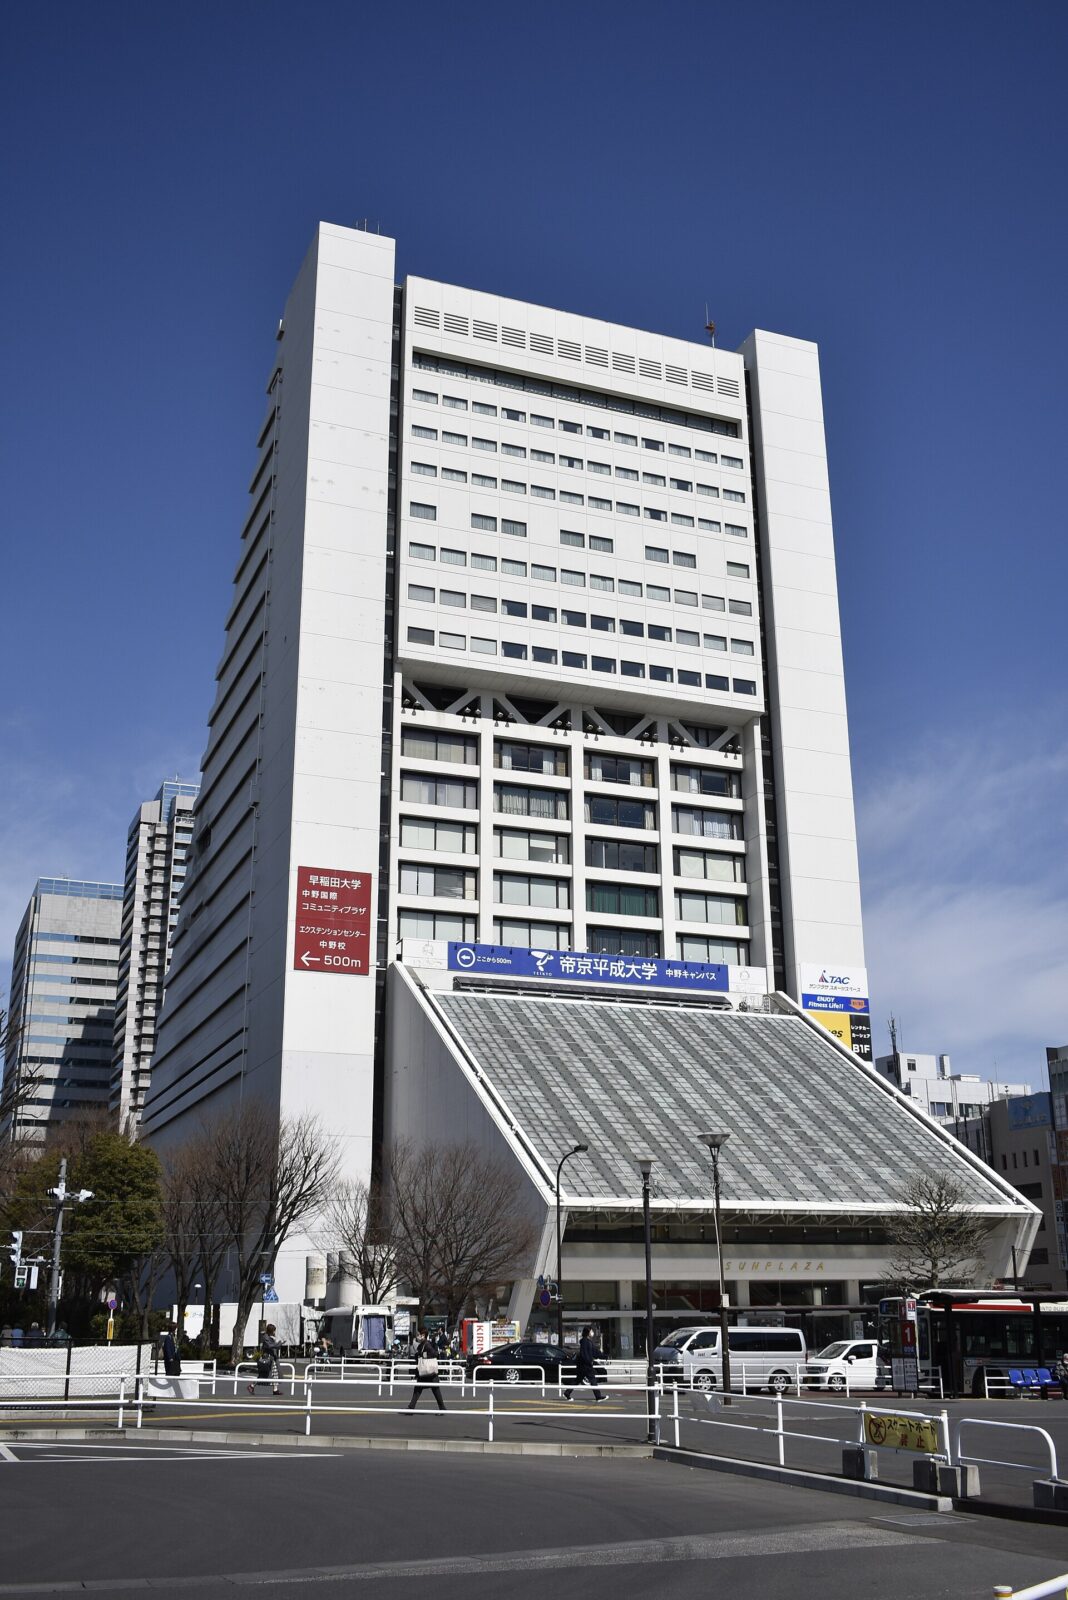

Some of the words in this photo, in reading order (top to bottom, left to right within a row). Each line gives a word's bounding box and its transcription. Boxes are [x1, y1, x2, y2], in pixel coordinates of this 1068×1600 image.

[309, 875, 362, 889] 早稲田大学
[302, 890, 338, 900] 中野国際
[302, 903, 367, 915] コミュニティプラザ
[299, 926, 367, 937] エクステンションセンター
[319, 940, 346, 950] 中野校
[324, 955, 361, 967] 500m
[476, 956, 512, 965] ここから500m
[559, 956, 658, 980] 帝京平成大学
[666, 967, 717, 981] 中野キャンパス
[808, 1001, 828, 1009] Fitness
[828, 1002, 844, 1010] Life!!
[829, 1029, 843, 1038] es
[852, 1044, 871, 1054] B1F
[725, 1261, 825, 1271] SUNPLAZA
[476, 1325, 484, 1354] KIRIN
[904, 1327, 911, 1343] 1
